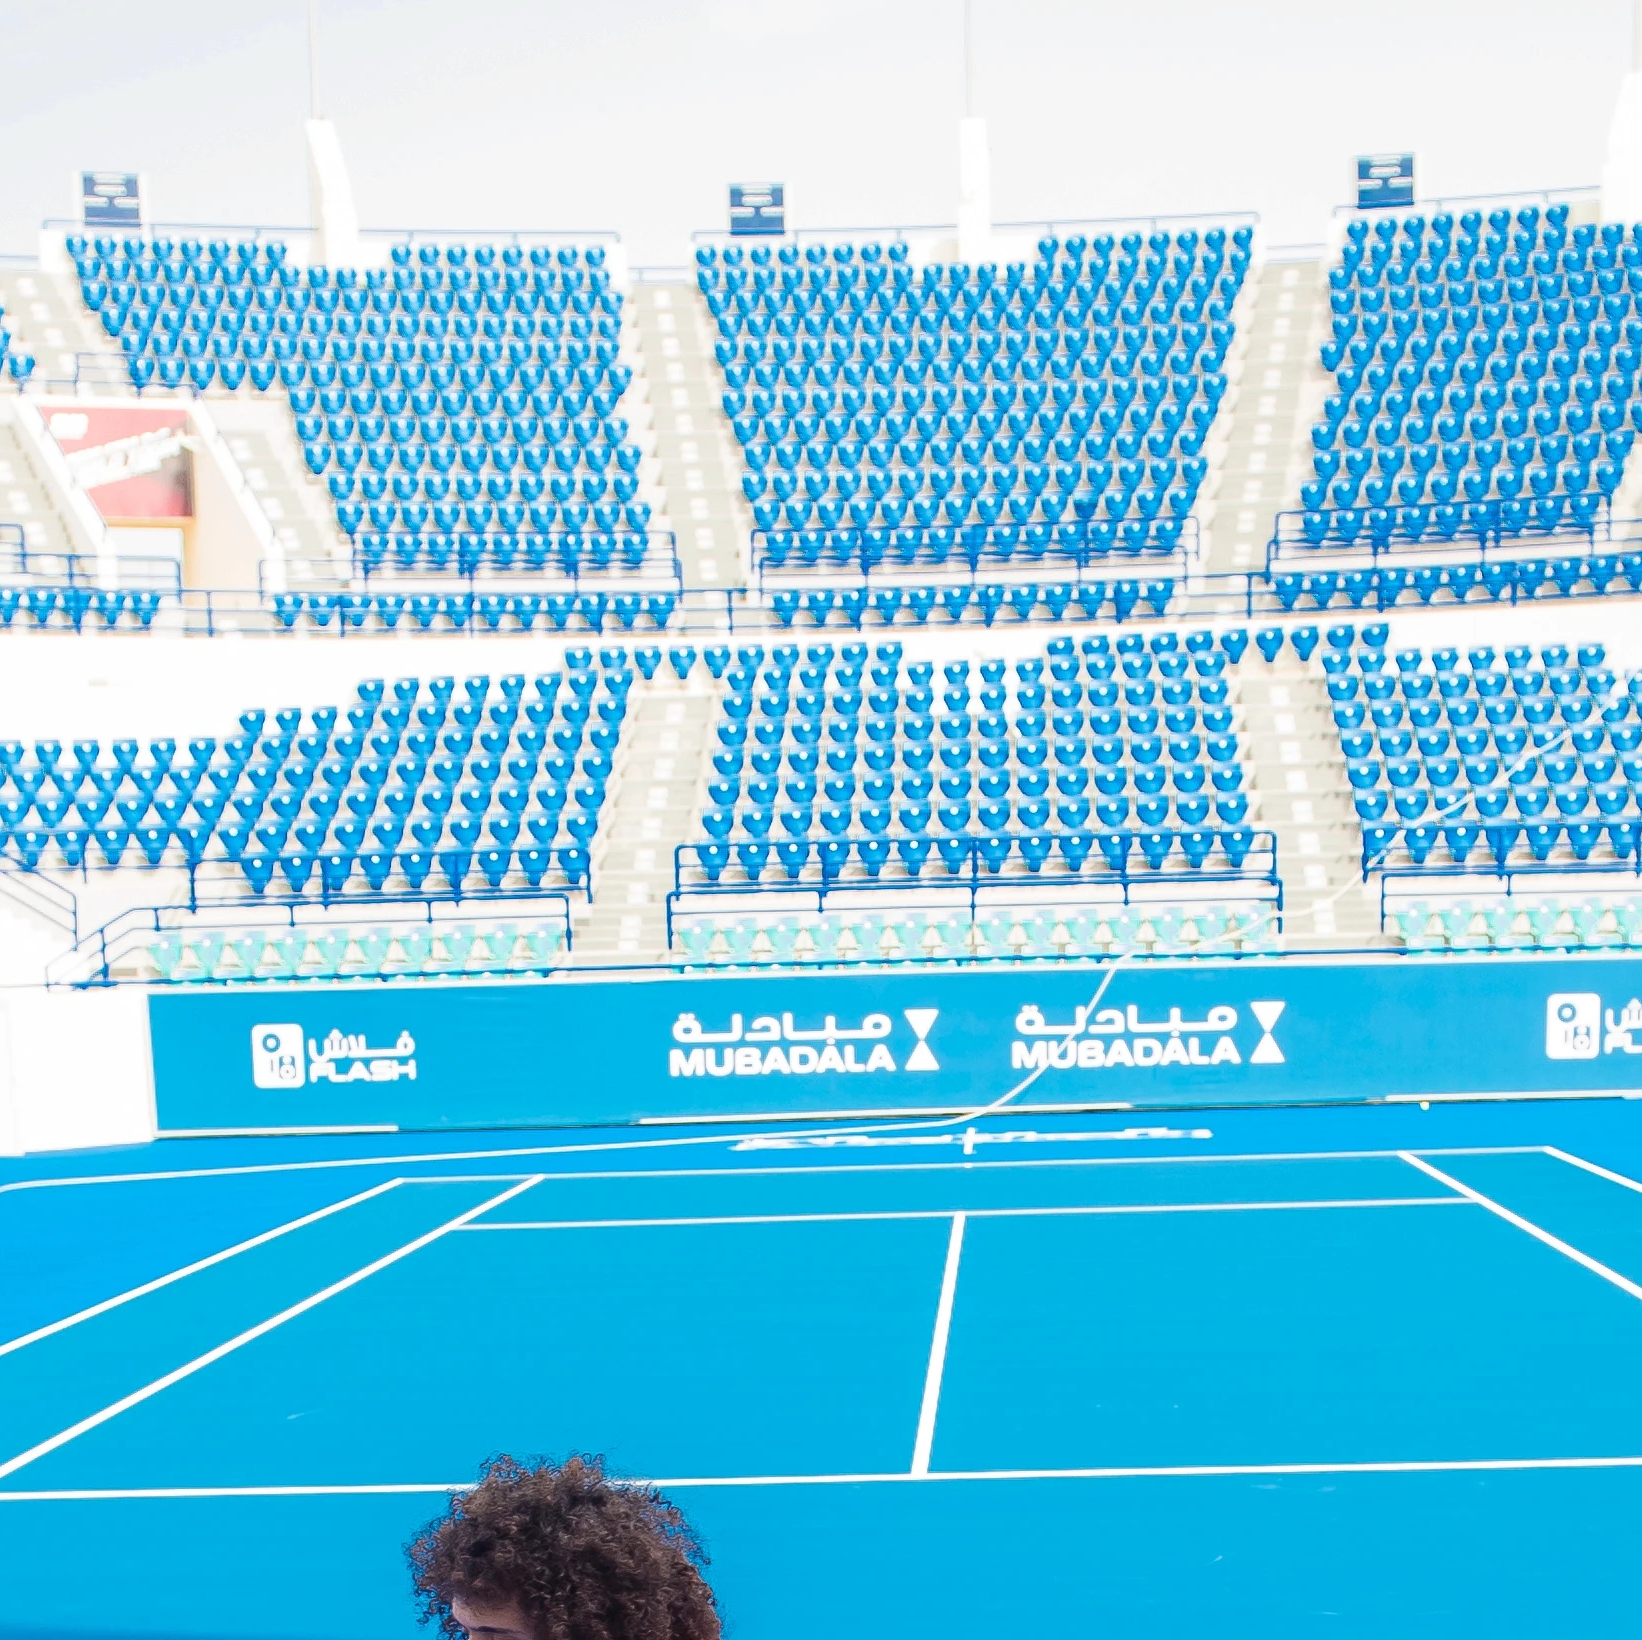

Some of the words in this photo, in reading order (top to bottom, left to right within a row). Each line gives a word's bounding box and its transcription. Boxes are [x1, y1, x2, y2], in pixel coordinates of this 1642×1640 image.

[671, 1012, 893, 1045] مبادلة
[1014, 1004, 1239, 1038] مبادلة
[669, 1044, 898, 1077] MUBADALA
[1011, 1036, 1243, 1070] MUBADALA
[308, 1059, 418, 1083] FLASH
